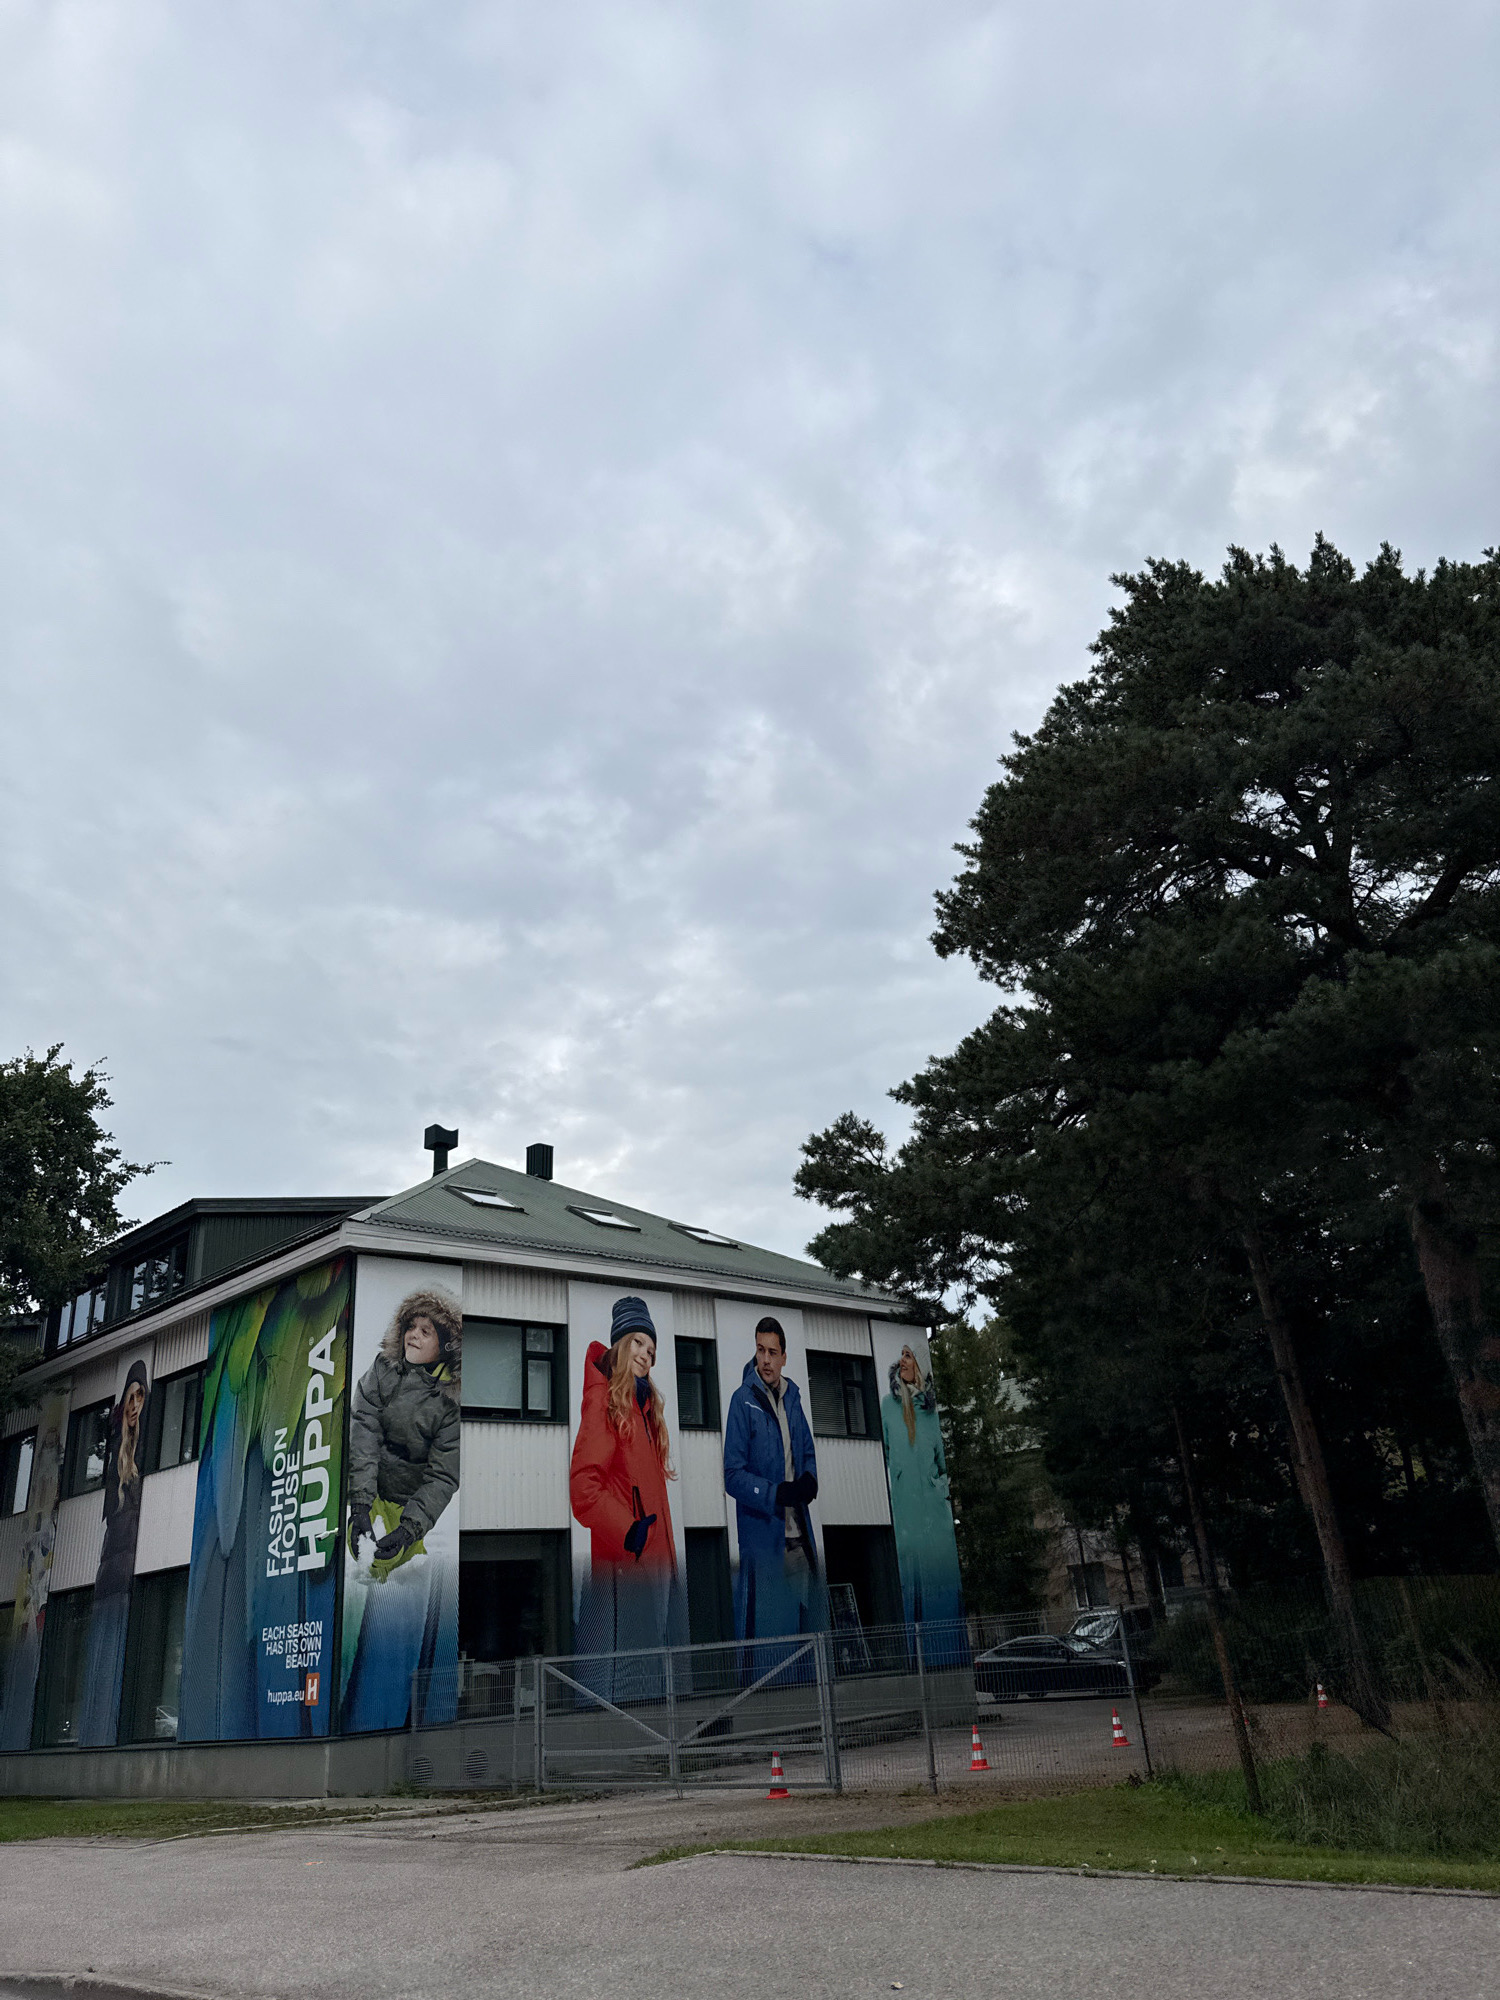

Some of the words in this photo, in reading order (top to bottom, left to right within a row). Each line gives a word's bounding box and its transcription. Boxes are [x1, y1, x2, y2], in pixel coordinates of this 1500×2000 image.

[266, 1426, 288, 1578] FASHION
[280, 1450, 301, 1576] HOUSE
[262, 1625, 286, 1642] EACH
[286, 1620, 323, 1639] SEASON
[265, 1640, 284, 1656] HAS
[285, 1638, 299, 1654] ITS
[300, 1636, 322, 1653] OWN
[285, 1651, 321, 1669] BEAUTY
[267, 1689, 305, 1706] huppa.eu
[307, 1678, 318, 1701] H
